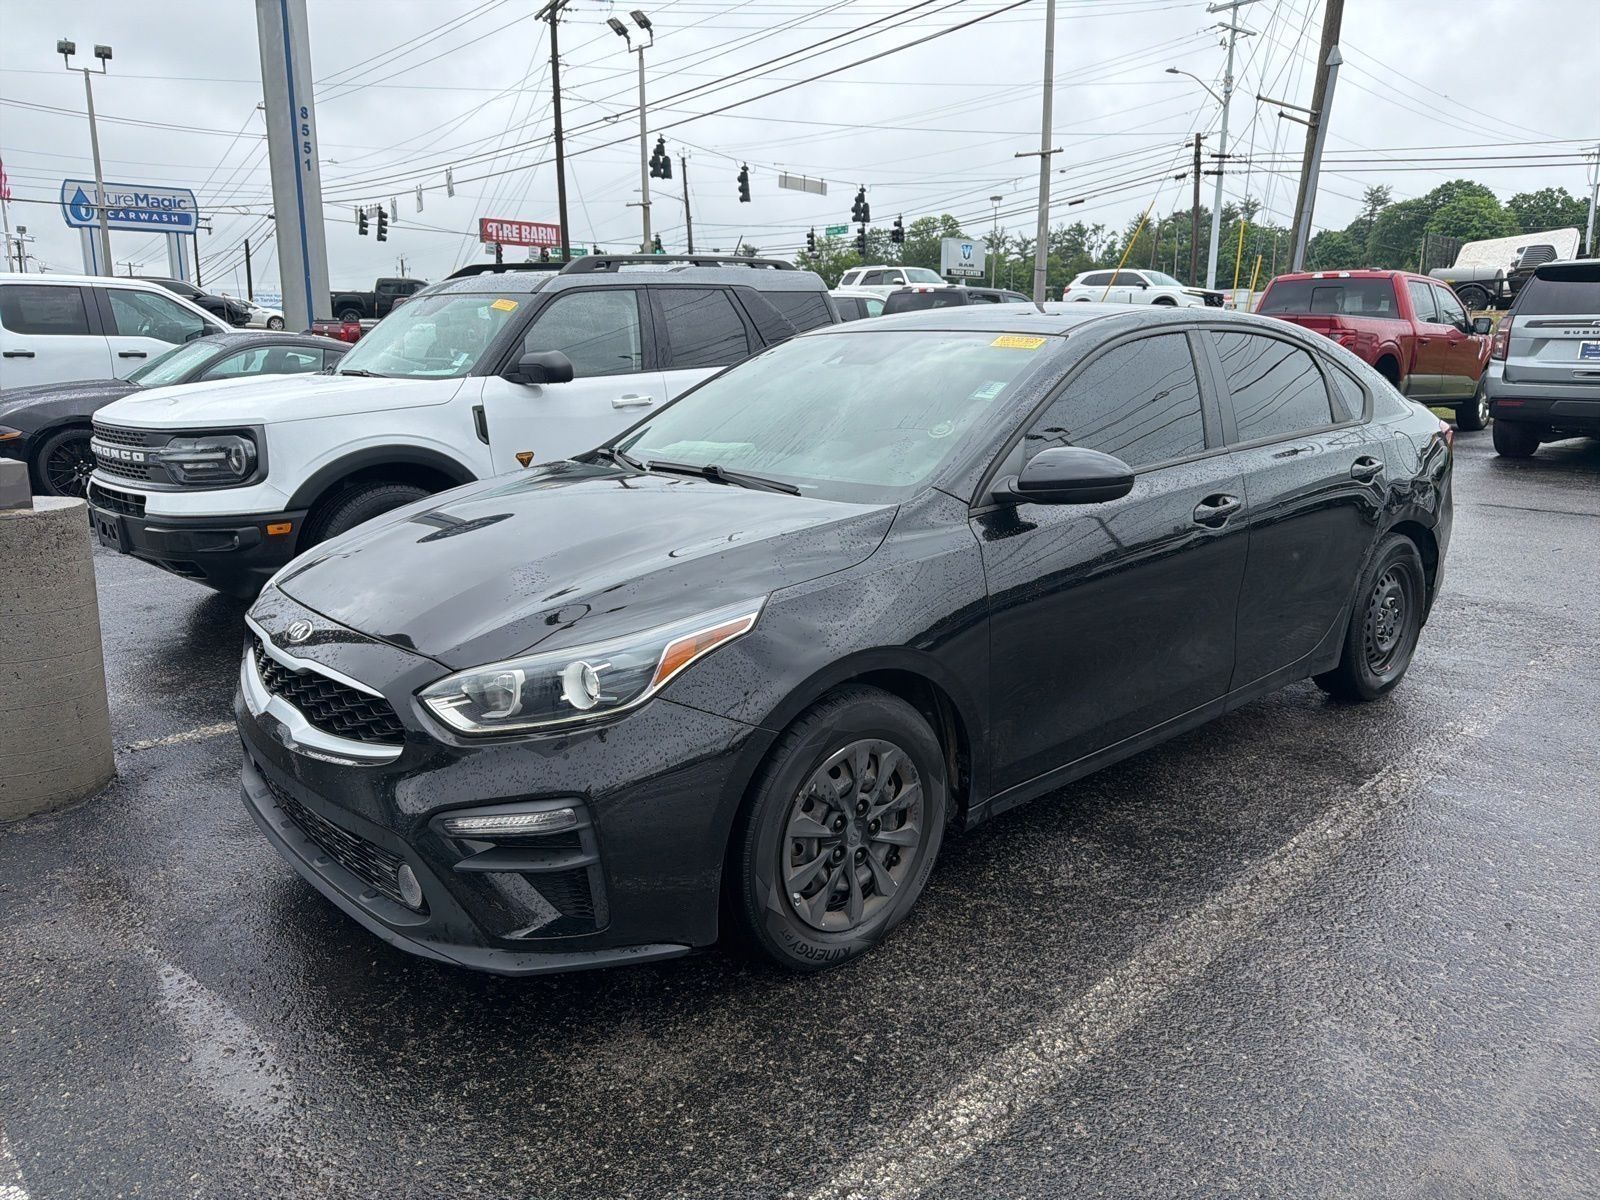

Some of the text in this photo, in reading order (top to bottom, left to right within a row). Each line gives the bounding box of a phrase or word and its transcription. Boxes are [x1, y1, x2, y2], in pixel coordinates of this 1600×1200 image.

[300, 106, 311, 172] 8551
[107, 210, 179, 223] CARWASH
[487, 222, 556, 245] TIRE BARN
[91, 443, 144, 462] BRONCO
[788, 940, 852, 961] KINERGY
